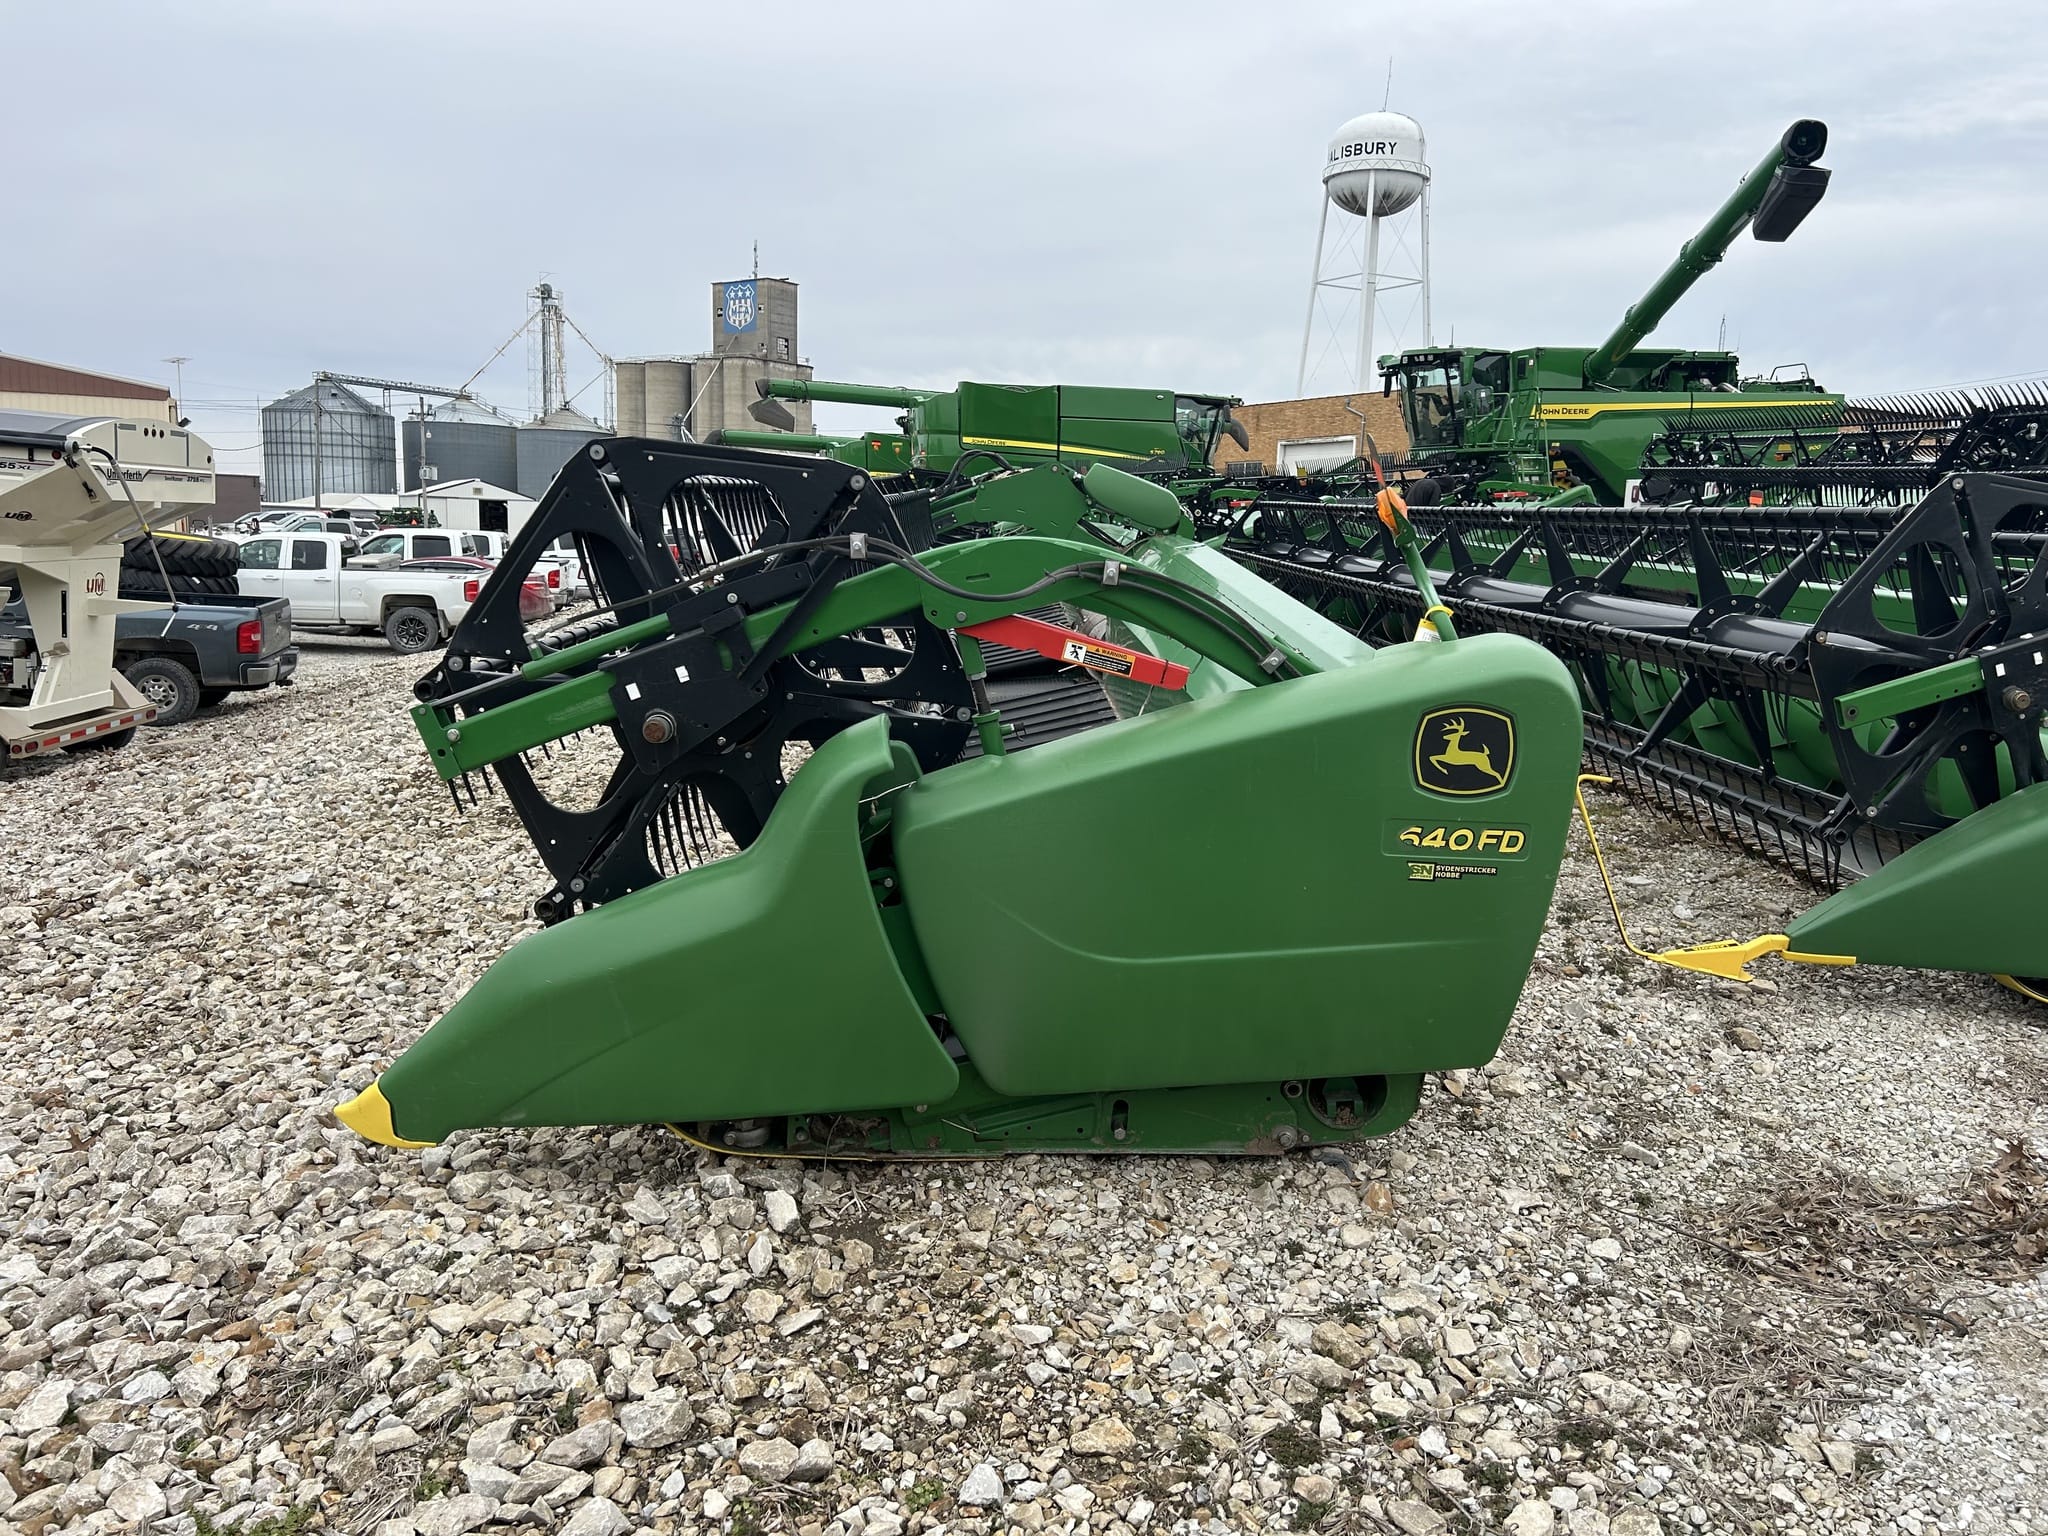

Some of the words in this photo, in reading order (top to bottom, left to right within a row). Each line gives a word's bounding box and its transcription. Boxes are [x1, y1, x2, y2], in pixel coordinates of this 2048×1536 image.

[1561, 407, 1590, 415] DEERE
[106, 468, 143, 480] Unrferth
[5, 511, 32, 521] UM
[86, 578, 104, 593] UM
[1102, 649, 1127, 660] WARNING
[1435, 865, 1497, 874] SYDENSTRICKER
[1435, 871, 1461, 879] NOBBE
